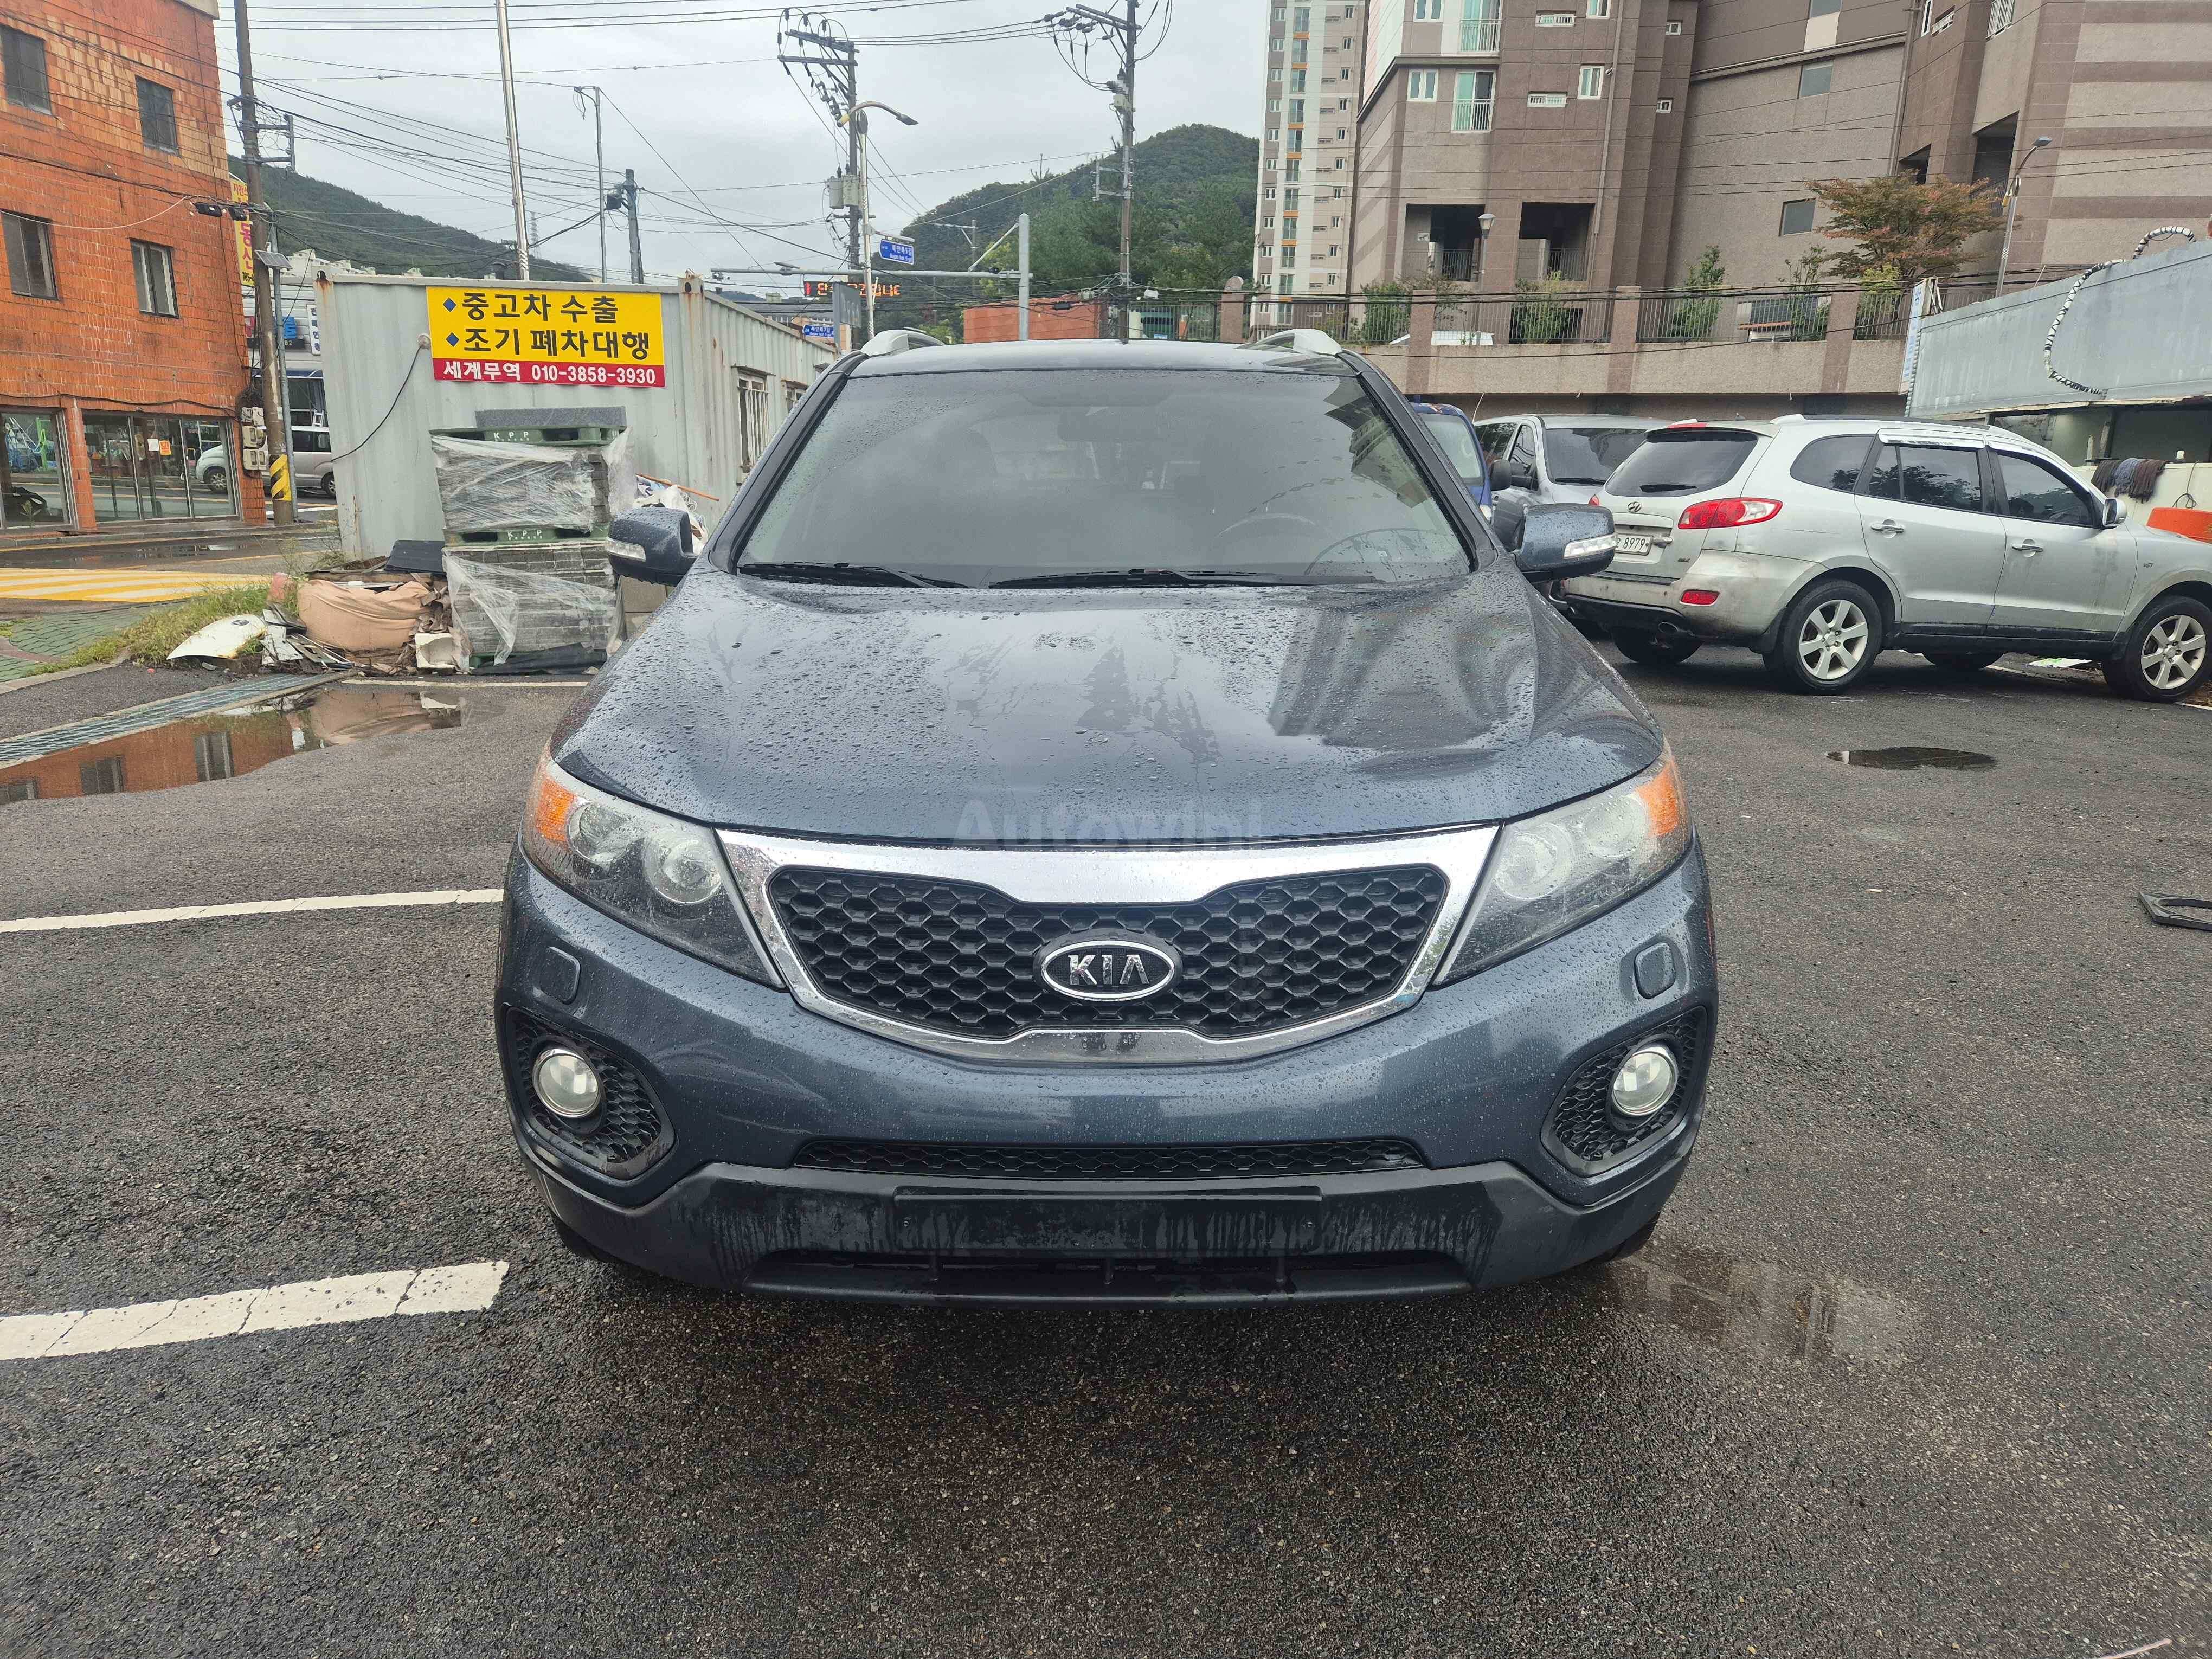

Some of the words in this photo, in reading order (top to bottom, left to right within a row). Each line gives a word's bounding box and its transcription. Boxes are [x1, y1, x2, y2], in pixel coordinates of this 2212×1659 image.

[462, 292, 551, 321] 중고차
[561, 295, 618, 324] 수출
[464, 328, 520, 355] 조기
[530, 329, 648, 360] 폐차대행
[443, 361, 520, 380] 세계무역
[531, 365, 655, 384] 010-3858-3930
[1623, 537, 1645, 550] 8979
[1068, 955, 1149, 985] KIA
